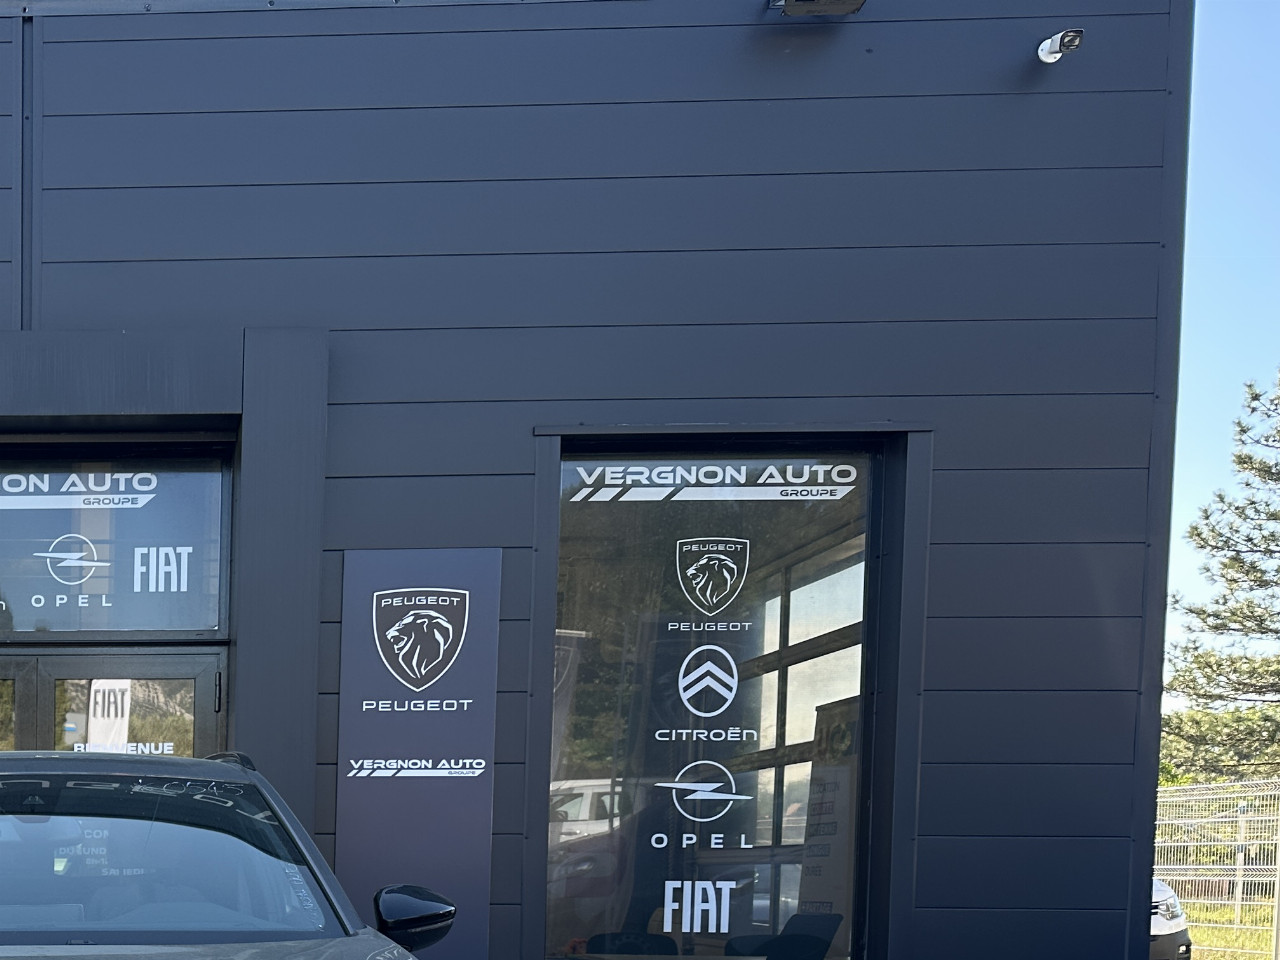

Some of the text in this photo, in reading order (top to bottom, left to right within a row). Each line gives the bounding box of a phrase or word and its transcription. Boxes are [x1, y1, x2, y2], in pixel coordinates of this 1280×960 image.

[576, 464, 858, 485] VERGNON AUTO
[60, 472, 158, 492] AUTO
[780, 488, 838, 498] GROUPE
[82, 496, 139, 506] GROUPE
[682, 543, 744, 552] PEUGEOT
[133, 546, 193, 593] FIAT
[30, 594, 113, 608] OPEL
[381, 596, 461, 608] PEUGEOT
[668, 622, 753, 632] PEUGEOT
[92, 687, 129, 719] FIAT
[362, 699, 474, 712] PEUGEOT
[349, 759, 486, 769] VERGNON AUTO
[650, 833, 754, 848] OPEL
[662, 880, 737, 933] FIAT
